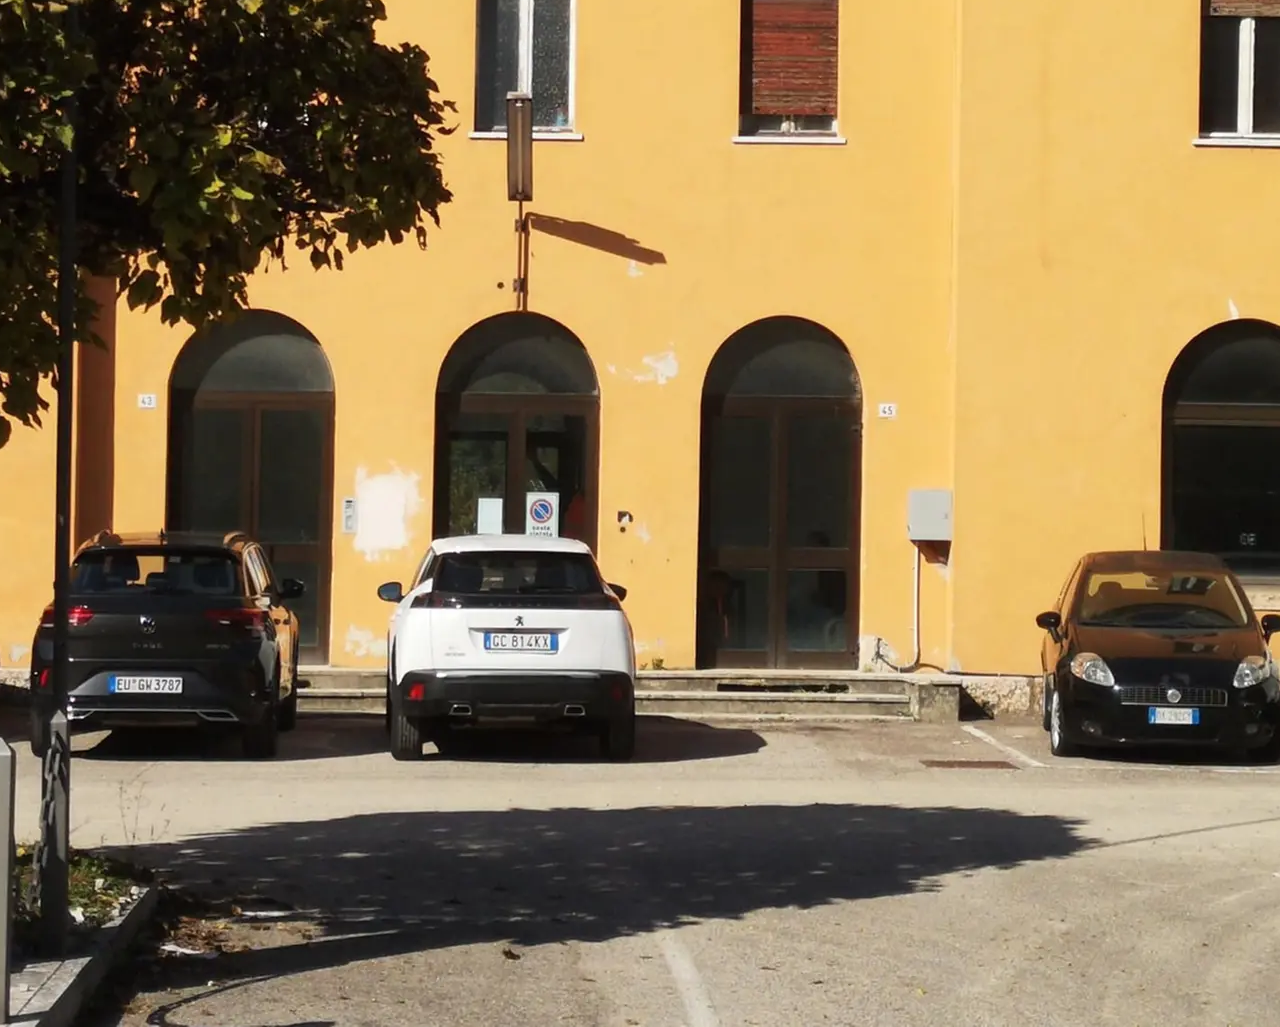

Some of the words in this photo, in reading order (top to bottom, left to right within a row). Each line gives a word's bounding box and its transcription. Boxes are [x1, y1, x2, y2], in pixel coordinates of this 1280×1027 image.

[881, 405, 893, 415] 45
[492, 635, 507, 647] GC
[511, 635, 549, 648] 814KX
[138, 679, 152, 691] GW
[155, 679, 182, 691] 3787
